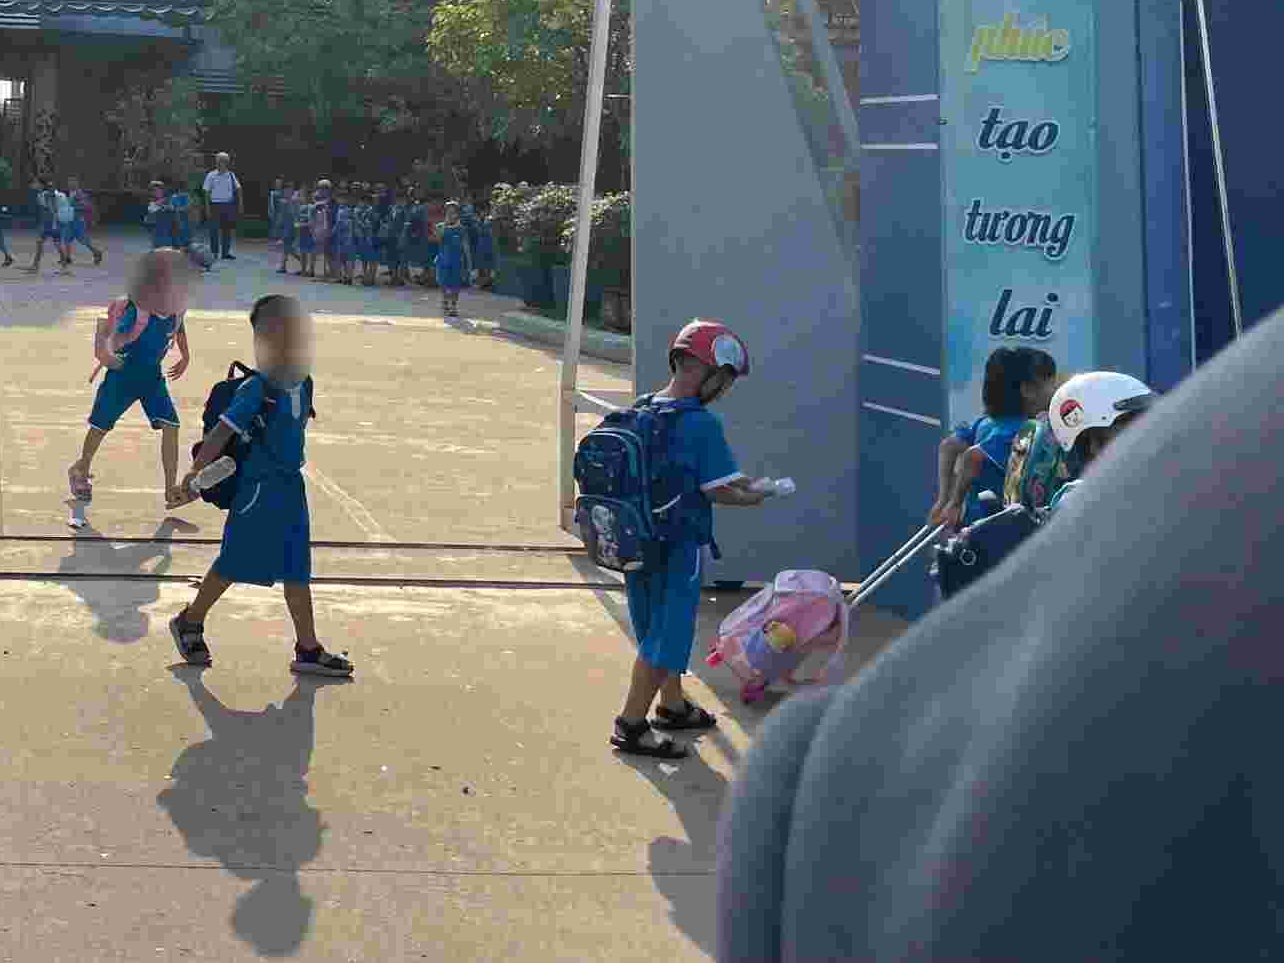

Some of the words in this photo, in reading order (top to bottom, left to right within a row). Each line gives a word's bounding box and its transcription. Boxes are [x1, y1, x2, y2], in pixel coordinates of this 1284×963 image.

[978, 107, 1059, 161] tạo
[965, 199, 1074, 258] tương
[989, 289, 1059, 337] lai
